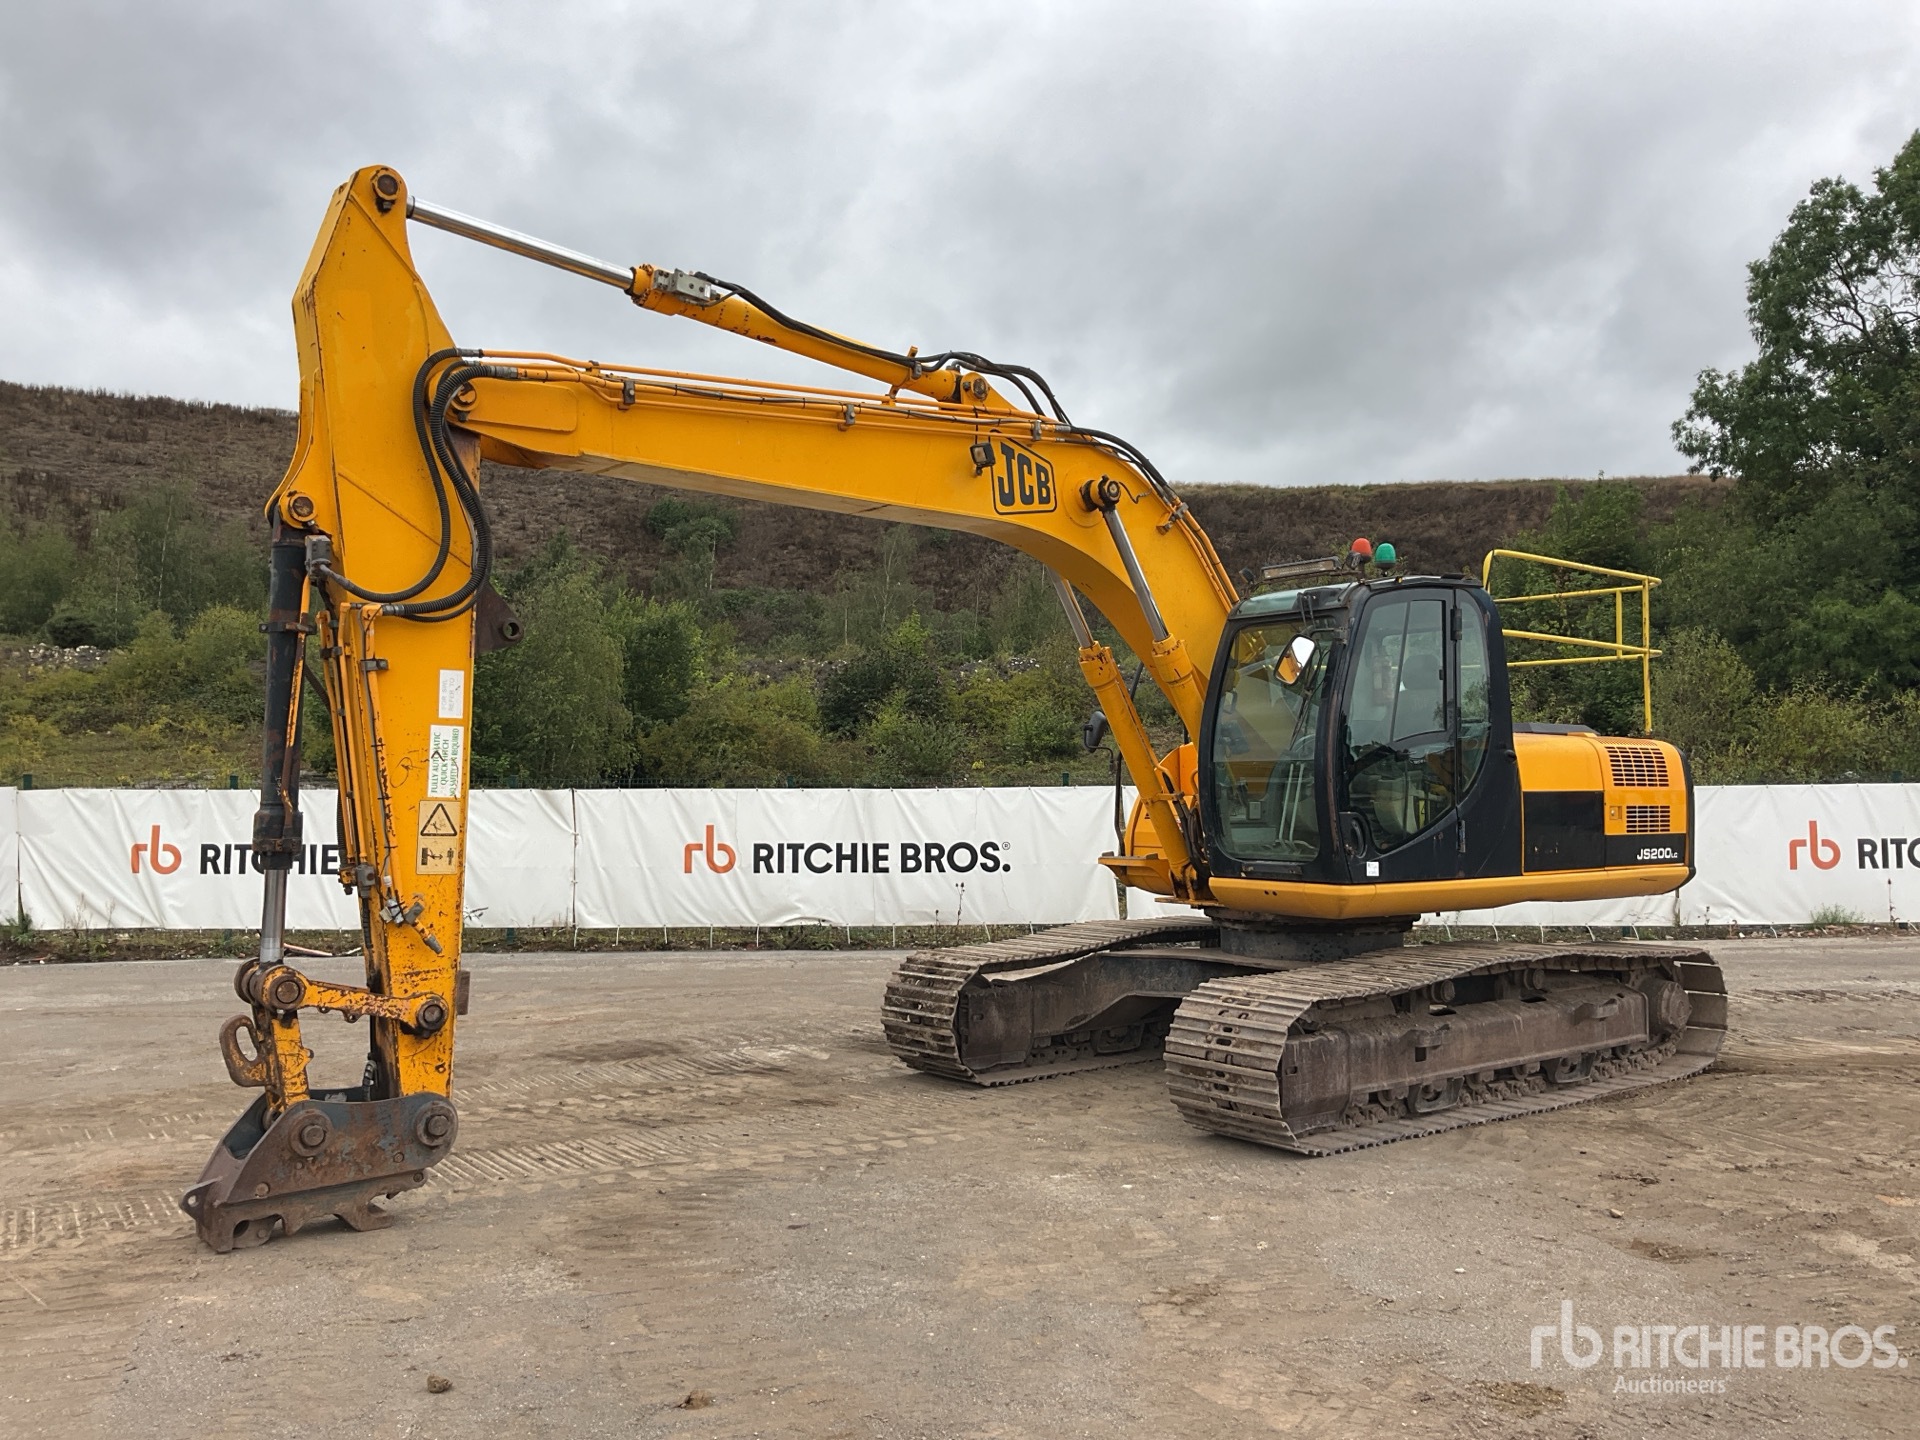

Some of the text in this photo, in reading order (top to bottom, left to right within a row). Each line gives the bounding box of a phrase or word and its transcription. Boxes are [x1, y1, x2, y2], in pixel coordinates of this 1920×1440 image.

[997, 441, 1051, 507] JCB
[451, 728, 460, 756] REQUIRED
[431, 774, 439, 793] FULLY
[440, 763, 449, 786] QUICK
[130, 824, 182, 874] rb
[684, 824, 737, 874] rb
[753, 842, 889, 874] RITCHIE
[1789, 820, 1841, 870] rb
